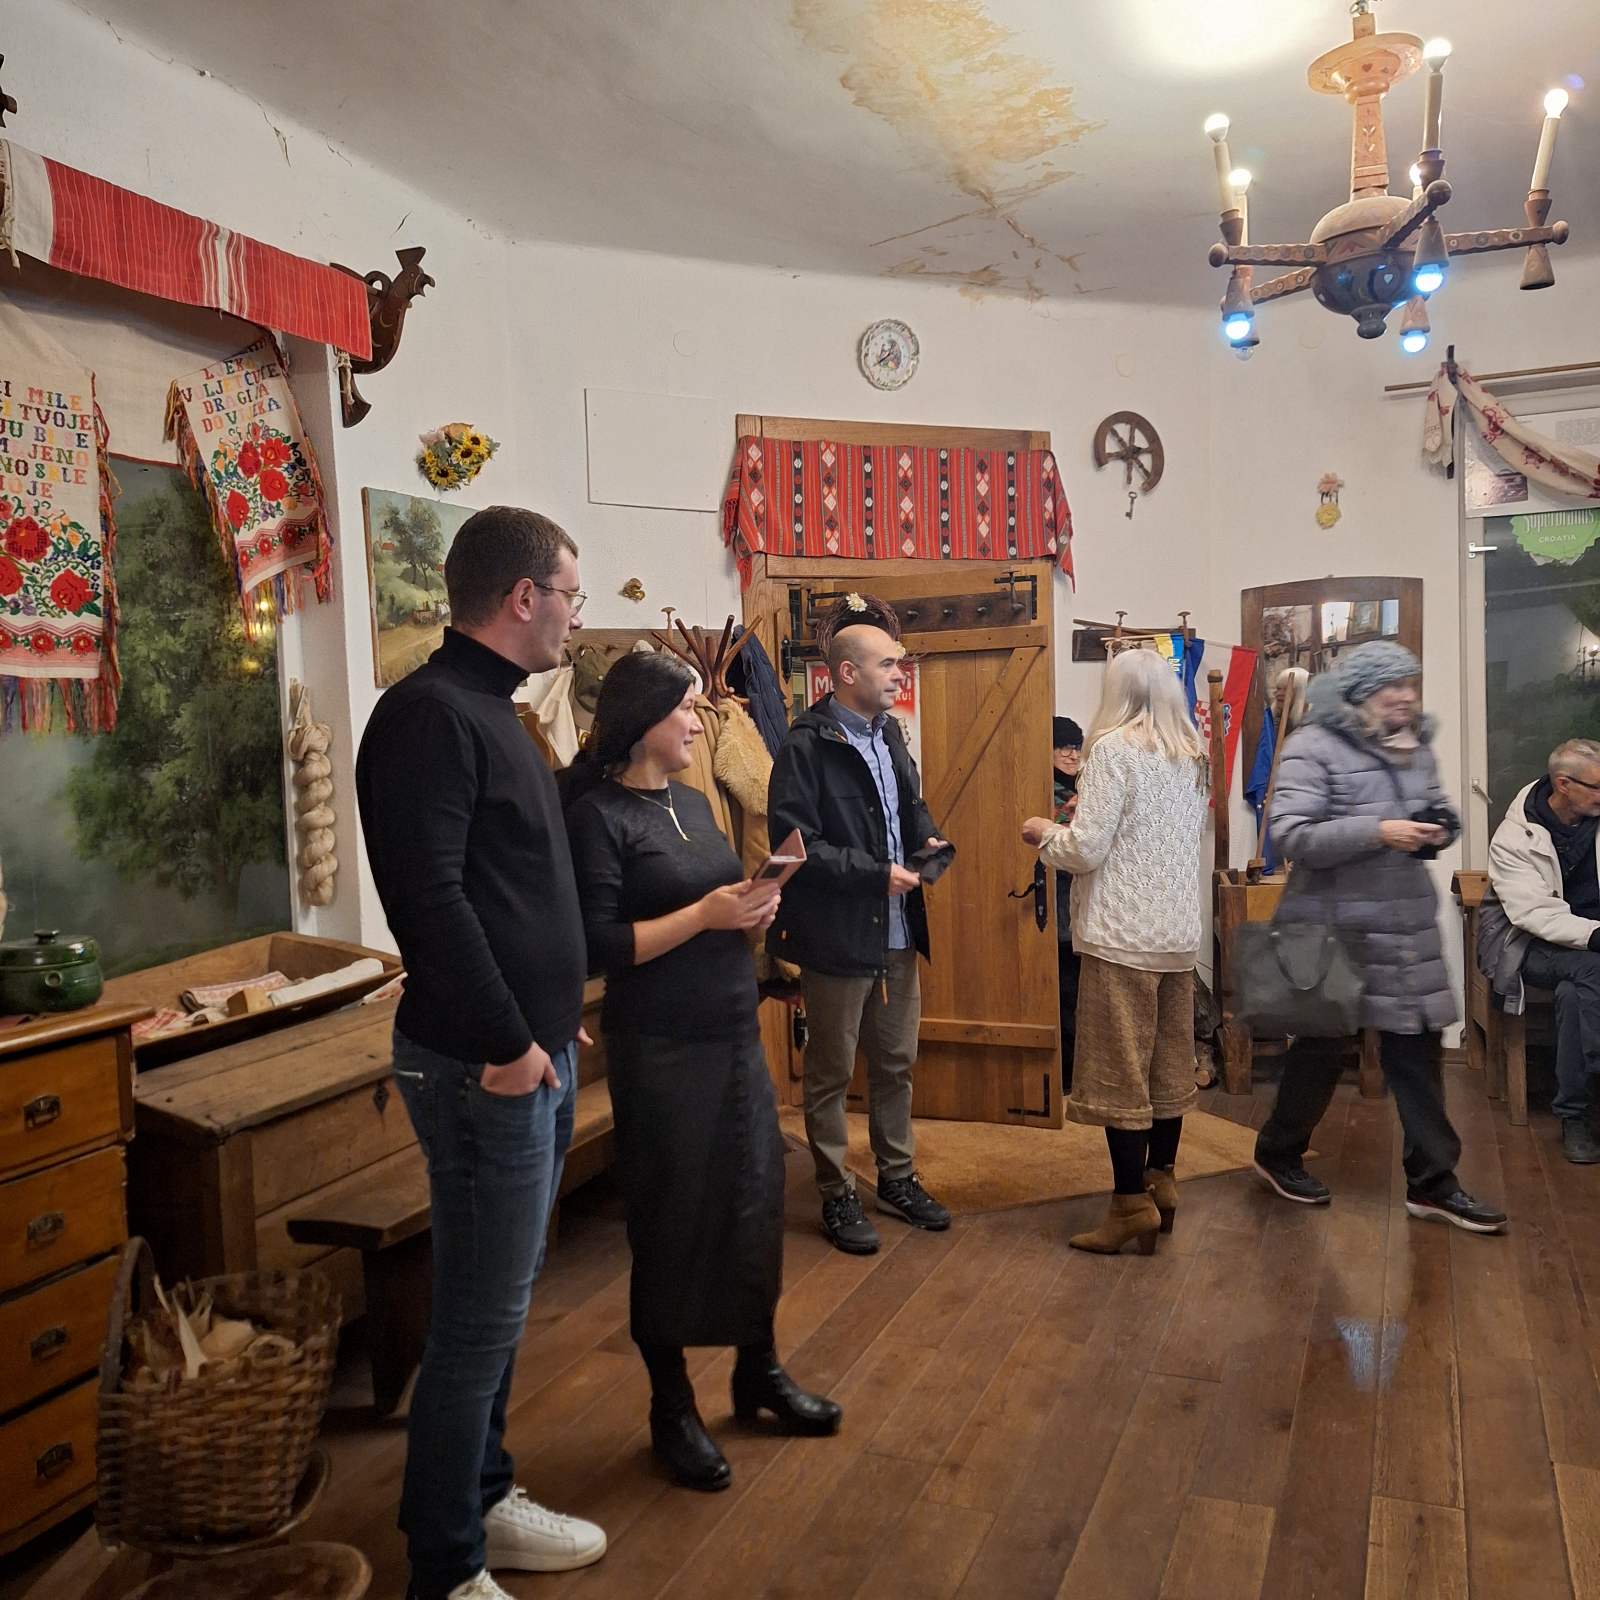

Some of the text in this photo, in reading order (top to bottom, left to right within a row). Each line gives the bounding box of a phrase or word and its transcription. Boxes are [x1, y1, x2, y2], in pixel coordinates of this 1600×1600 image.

[28, 386, 82, 411] MILE
[17, 403, 92, 430] TVOJE
[1538, 534, 1577, 544] CROATIA
